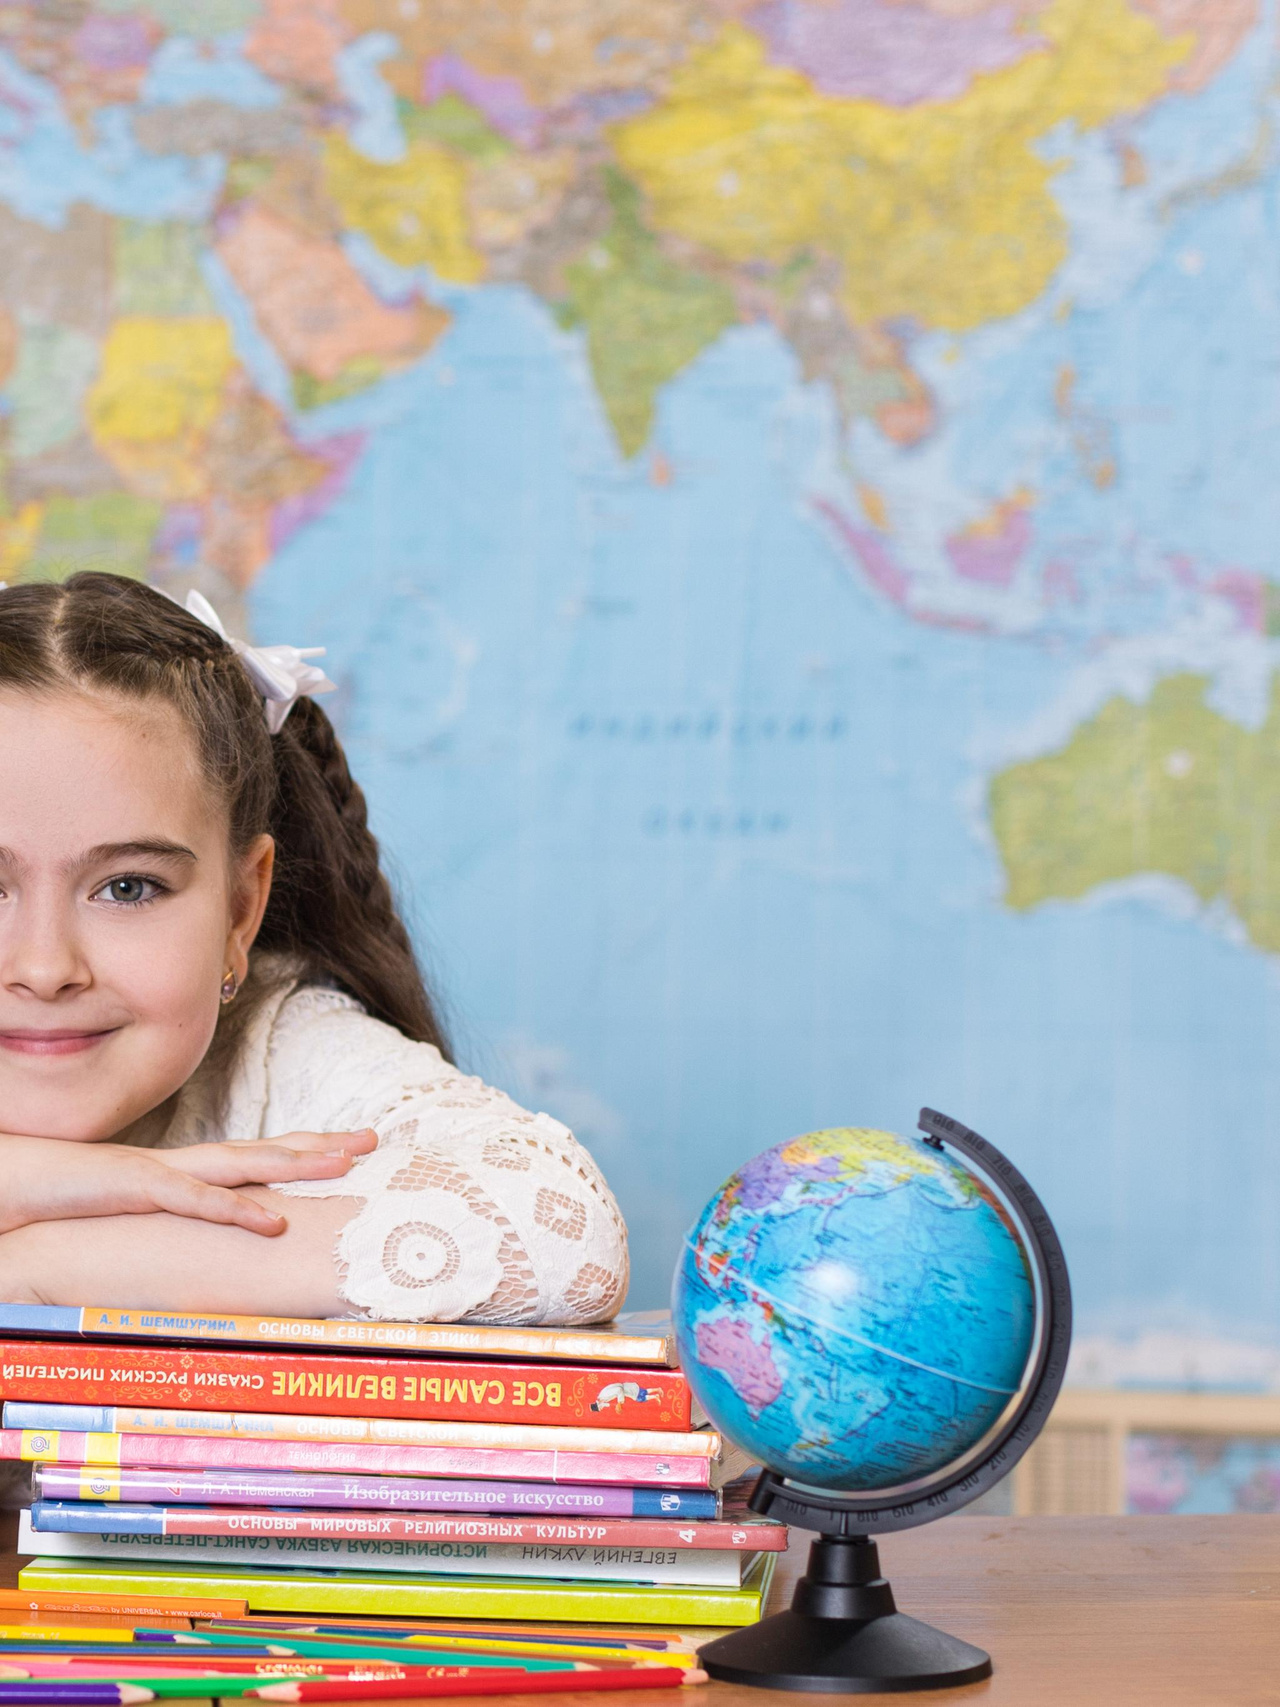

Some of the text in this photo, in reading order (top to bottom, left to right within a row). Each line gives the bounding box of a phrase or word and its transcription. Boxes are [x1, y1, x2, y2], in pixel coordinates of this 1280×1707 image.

[99, 1313, 480, 1345] А. И. ШЕМШУРИНА ОСНОВЫ СВЕТСКОЙ ЭТИКИ
[2, 1363, 264, 1390] СКАЗКИ РУССКИХ ПИСАТЕЛЕЙ
[272, 1371, 562, 1407] ВСЕ САМЫЕ ВЕЛИКИЕ
[175, 1416, 275, 1433] ШЕМШУРИНА
[296, 1421, 365, 1437] ОСНОВЫ
[200, 1482, 215, 1496] Л.
[221, 1482, 234, 1496] А.
[344, 1484, 604, 1508] Изобразительное искусство
[228, 1516, 607, 1540] ОСНОВЫ МИРОВЫХ РЕЛИГИОЗНЫХ КУЛЬТУР
[679, 1528, 697, 1544] 4
[275, 1537, 342, 1553] АЗБУКА
[347, 1540, 488, 1558] ИСТОРИЧЕСКАЯ
[522, 1545, 677, 1565] ЕВГЕНИЙ ЛУКИН
[111, 1606, 120, 1614] by
[122, 1607, 163, 1616] UNIVERSAL
[170, 1610, 222, 1618] www.carioca.it
